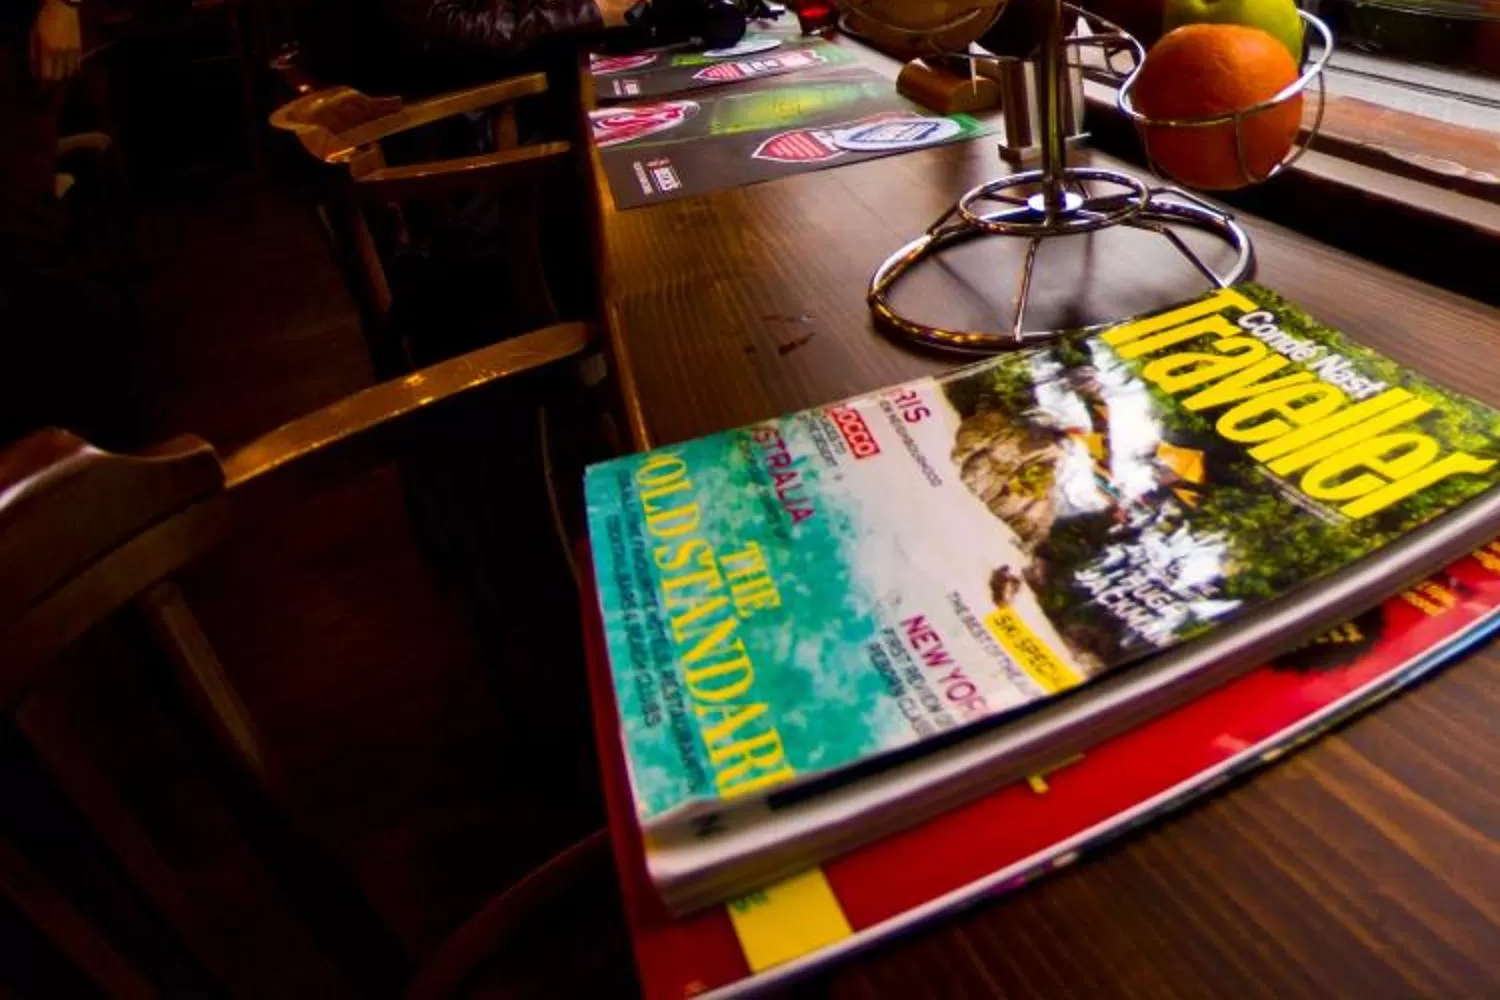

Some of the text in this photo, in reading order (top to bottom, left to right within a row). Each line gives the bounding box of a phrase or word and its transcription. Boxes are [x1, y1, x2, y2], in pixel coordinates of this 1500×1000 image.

[1238, 310, 1388, 400] Condé Nast
[1102, 287, 1498, 523] Traveller
[719, 539, 783, 618] THE
[899, 613, 954, 668] NEW
